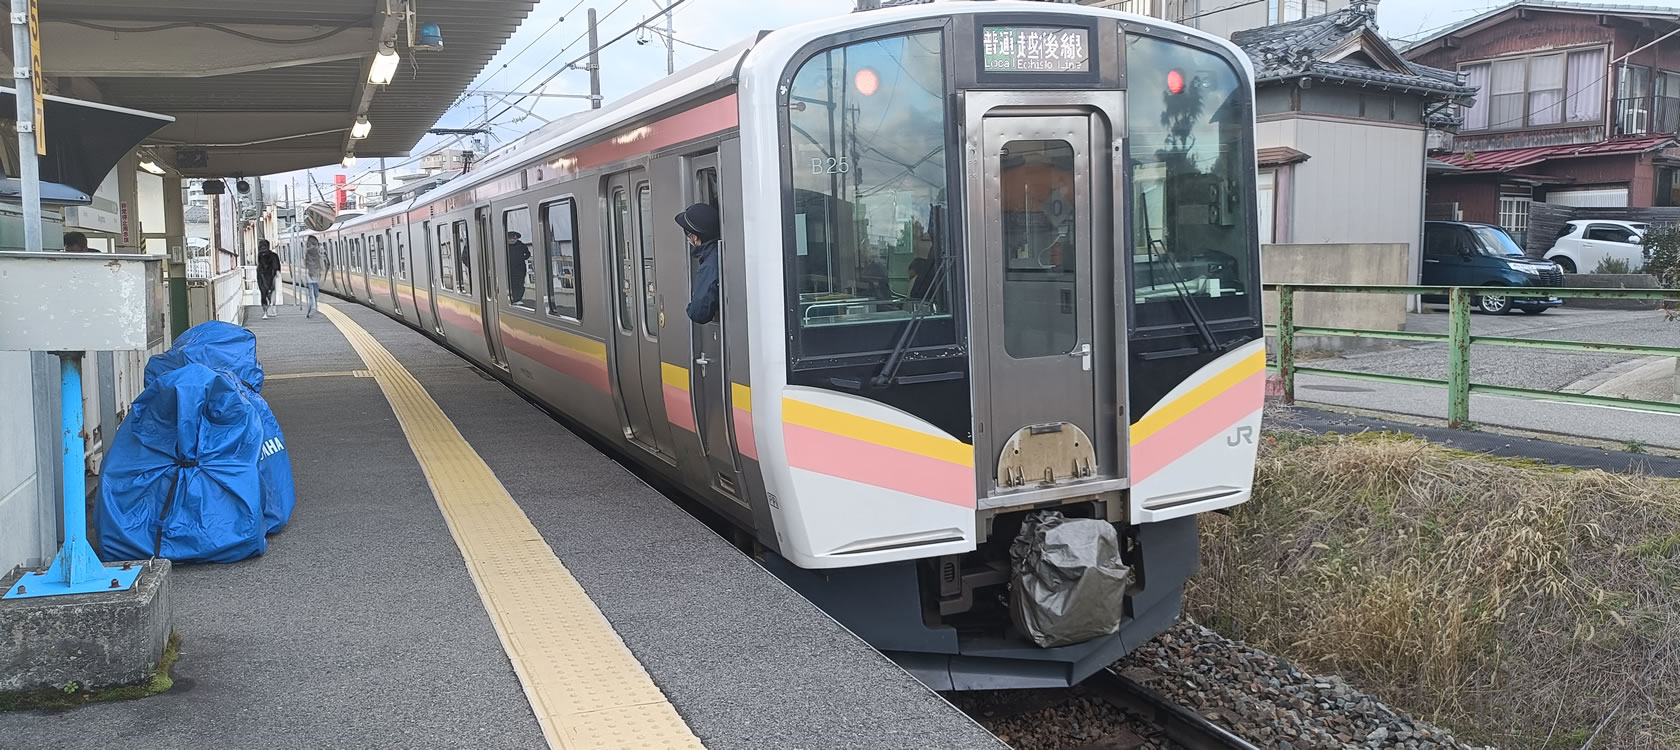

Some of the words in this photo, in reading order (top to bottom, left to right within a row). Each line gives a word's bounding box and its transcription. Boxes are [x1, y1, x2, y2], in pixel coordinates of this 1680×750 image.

[983, 31, 1014, 55] 普通
[1017, 32, 1082, 59] 越後線
[34, 55, 41, 95] 6
[812, 157, 849, 174] B25
[260, 436, 284, 460] AHA
[1227, 425, 1252, 447] JR
